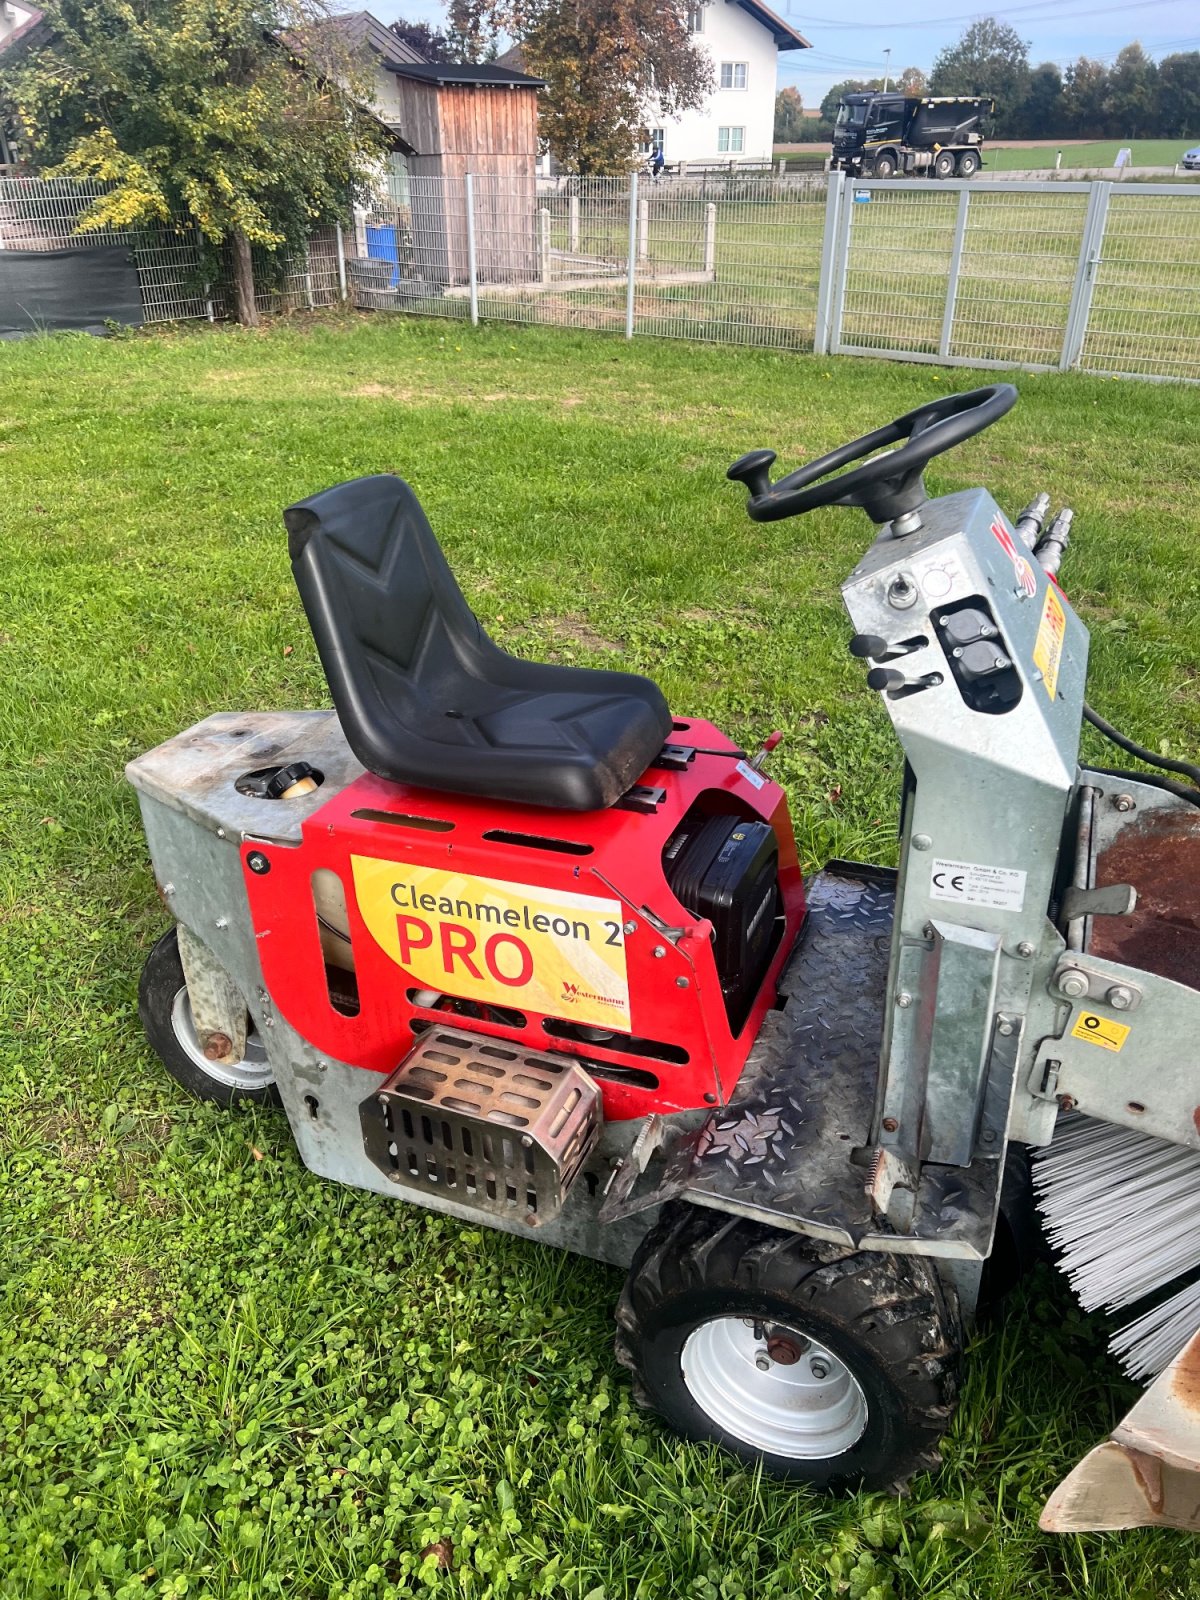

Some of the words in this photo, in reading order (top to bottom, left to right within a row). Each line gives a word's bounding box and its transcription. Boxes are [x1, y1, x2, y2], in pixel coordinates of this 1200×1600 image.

[390, 883, 590, 942] Cleanmeleon
[604, 921, 623, 947] 2
[395, 913, 534, 988] PRO
[562, 981, 625, 1006] Westermann
